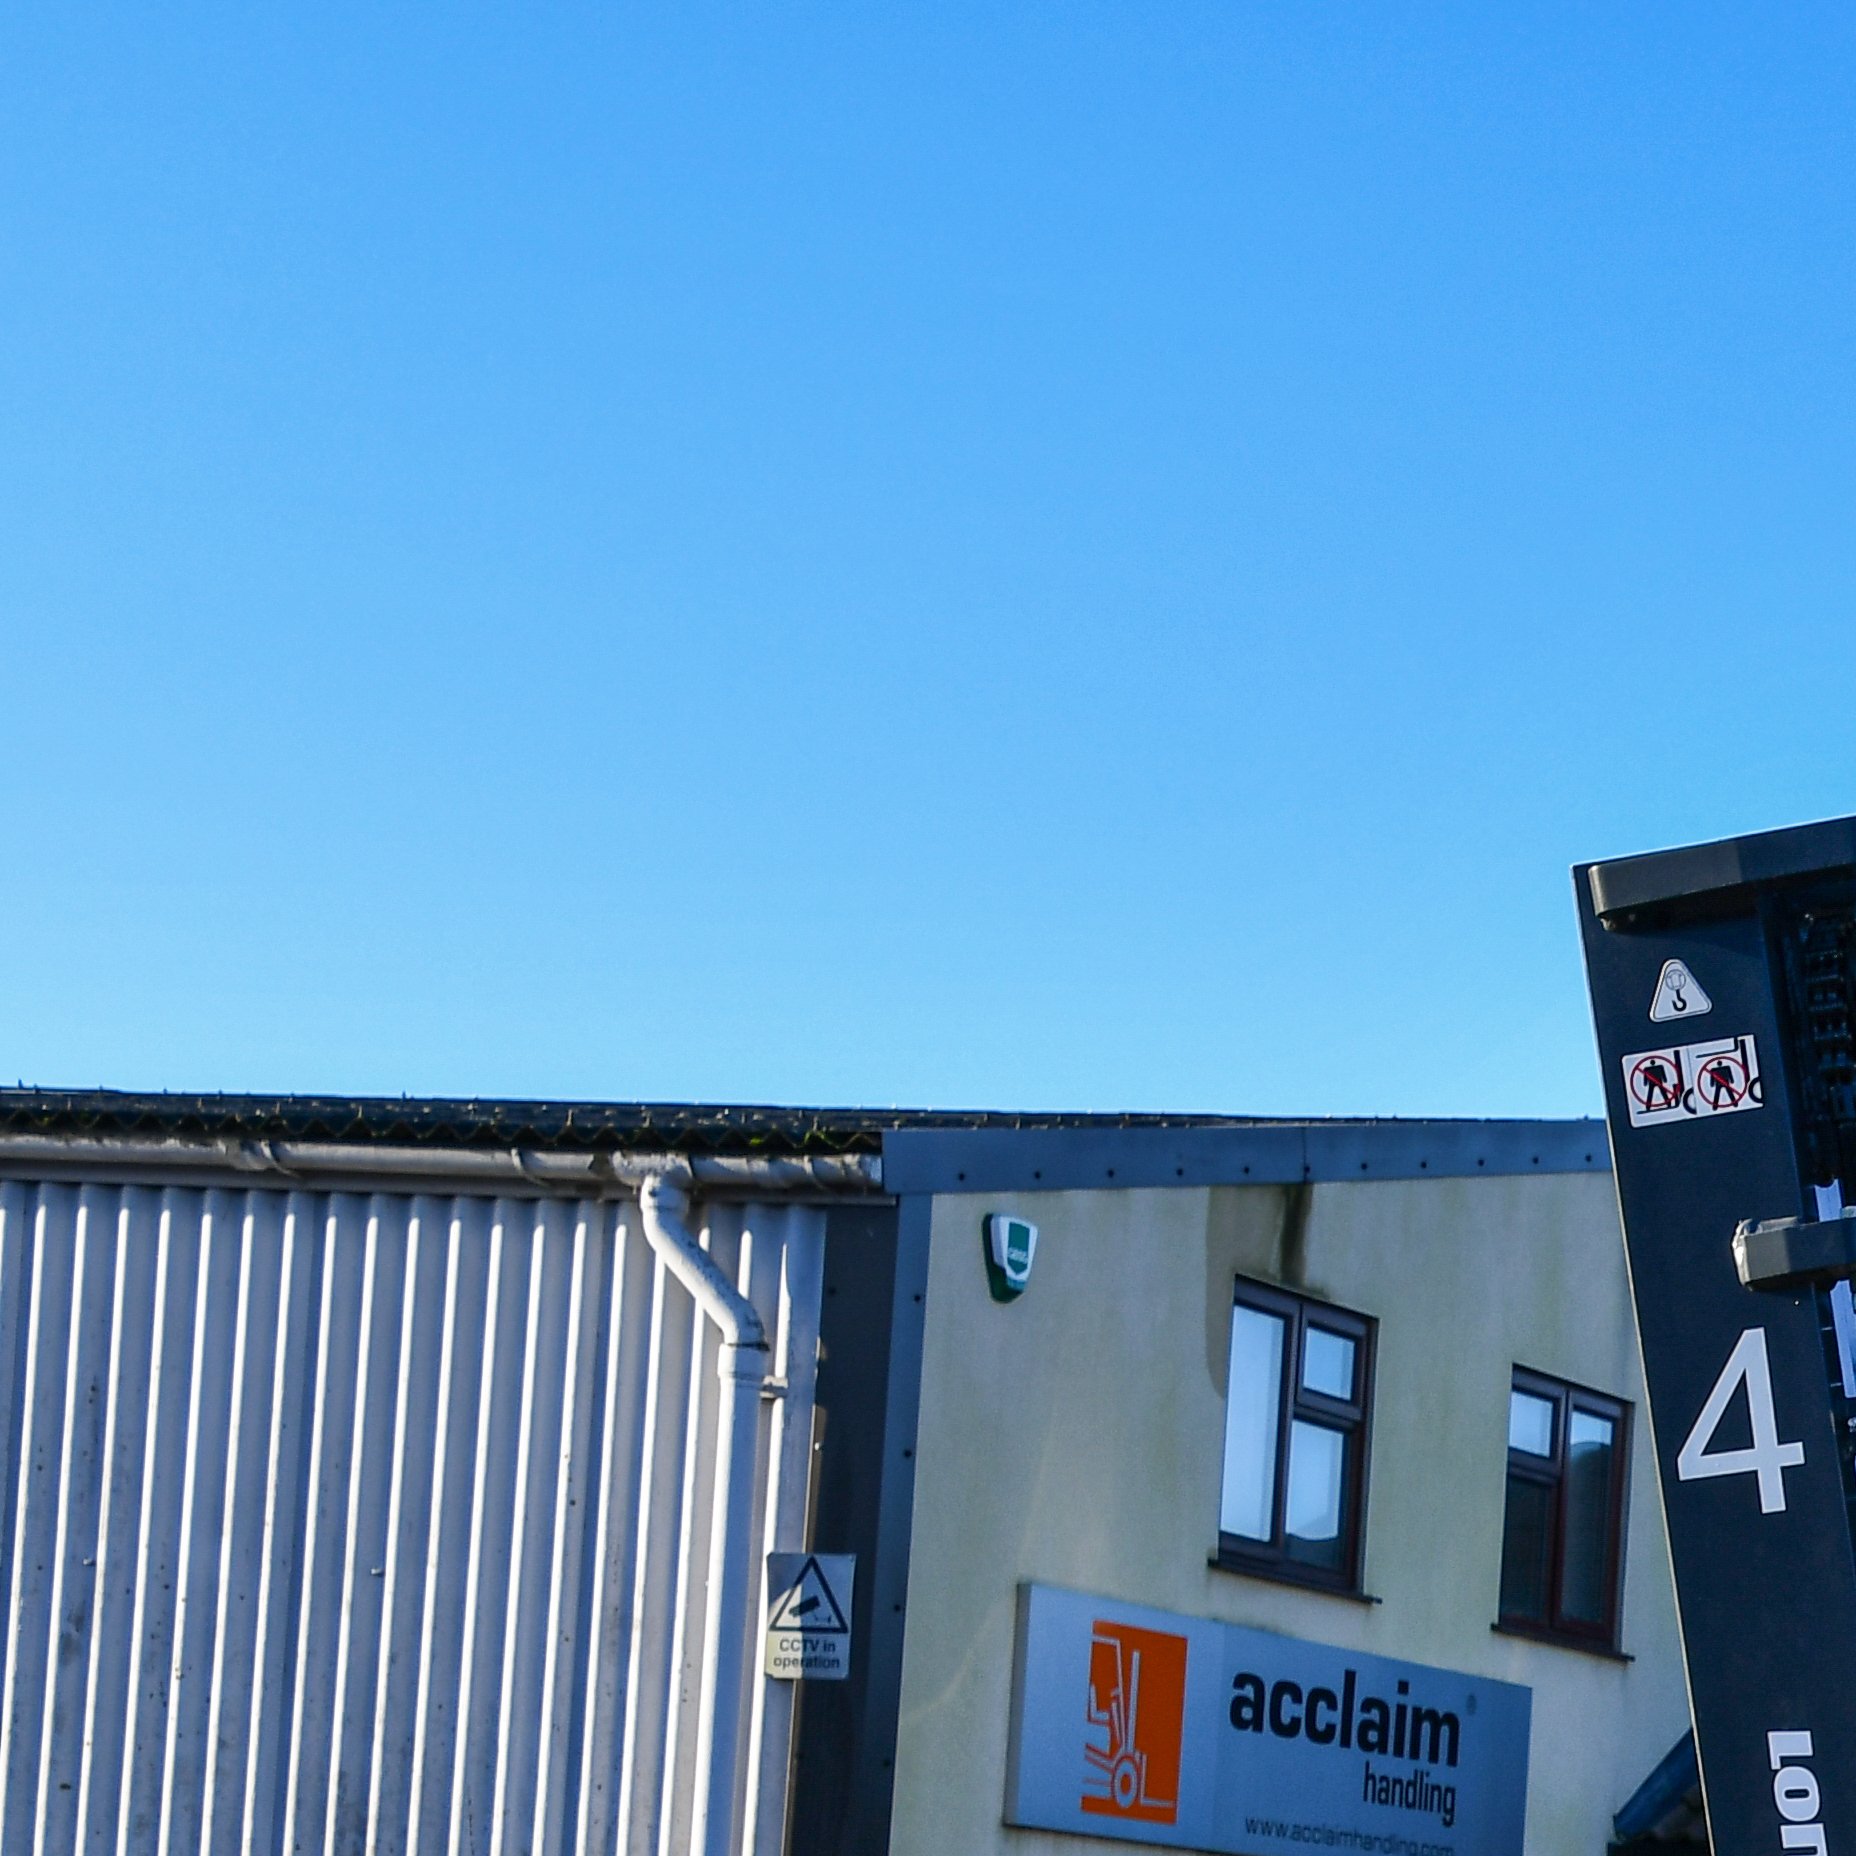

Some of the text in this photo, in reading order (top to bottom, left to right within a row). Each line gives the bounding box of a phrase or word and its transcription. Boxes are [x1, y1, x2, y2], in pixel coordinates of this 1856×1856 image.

[1677, 1326, 1805, 1514] 4
[773, 1655, 840, 1669] operation
[779, 1638, 837, 1653] CCTV in
[1229, 1668, 1460, 1768] acclaim
[1362, 1759, 1456, 1828] handling
